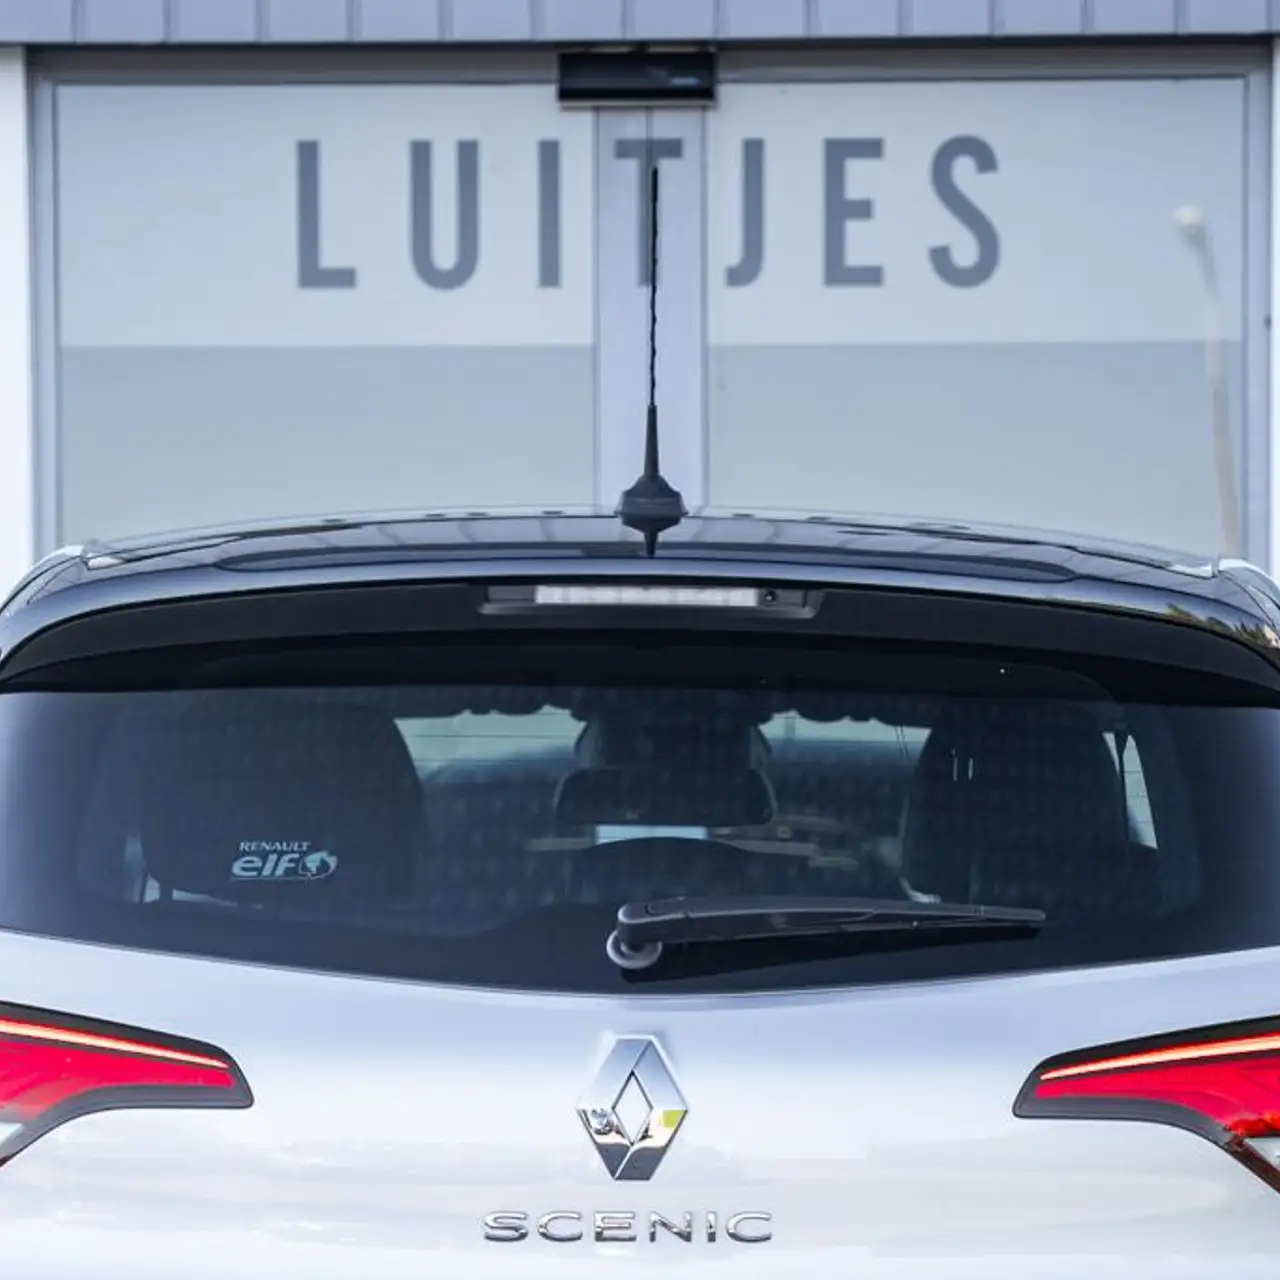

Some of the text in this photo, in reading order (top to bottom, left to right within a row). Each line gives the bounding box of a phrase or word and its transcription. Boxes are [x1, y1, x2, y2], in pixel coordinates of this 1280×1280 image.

[295, 134, 1001, 288] LUITJES
[239, 841, 310, 852] RENAULT
[231, 853, 300, 876] elf
[483, 1210, 773, 1244] SCENIC
